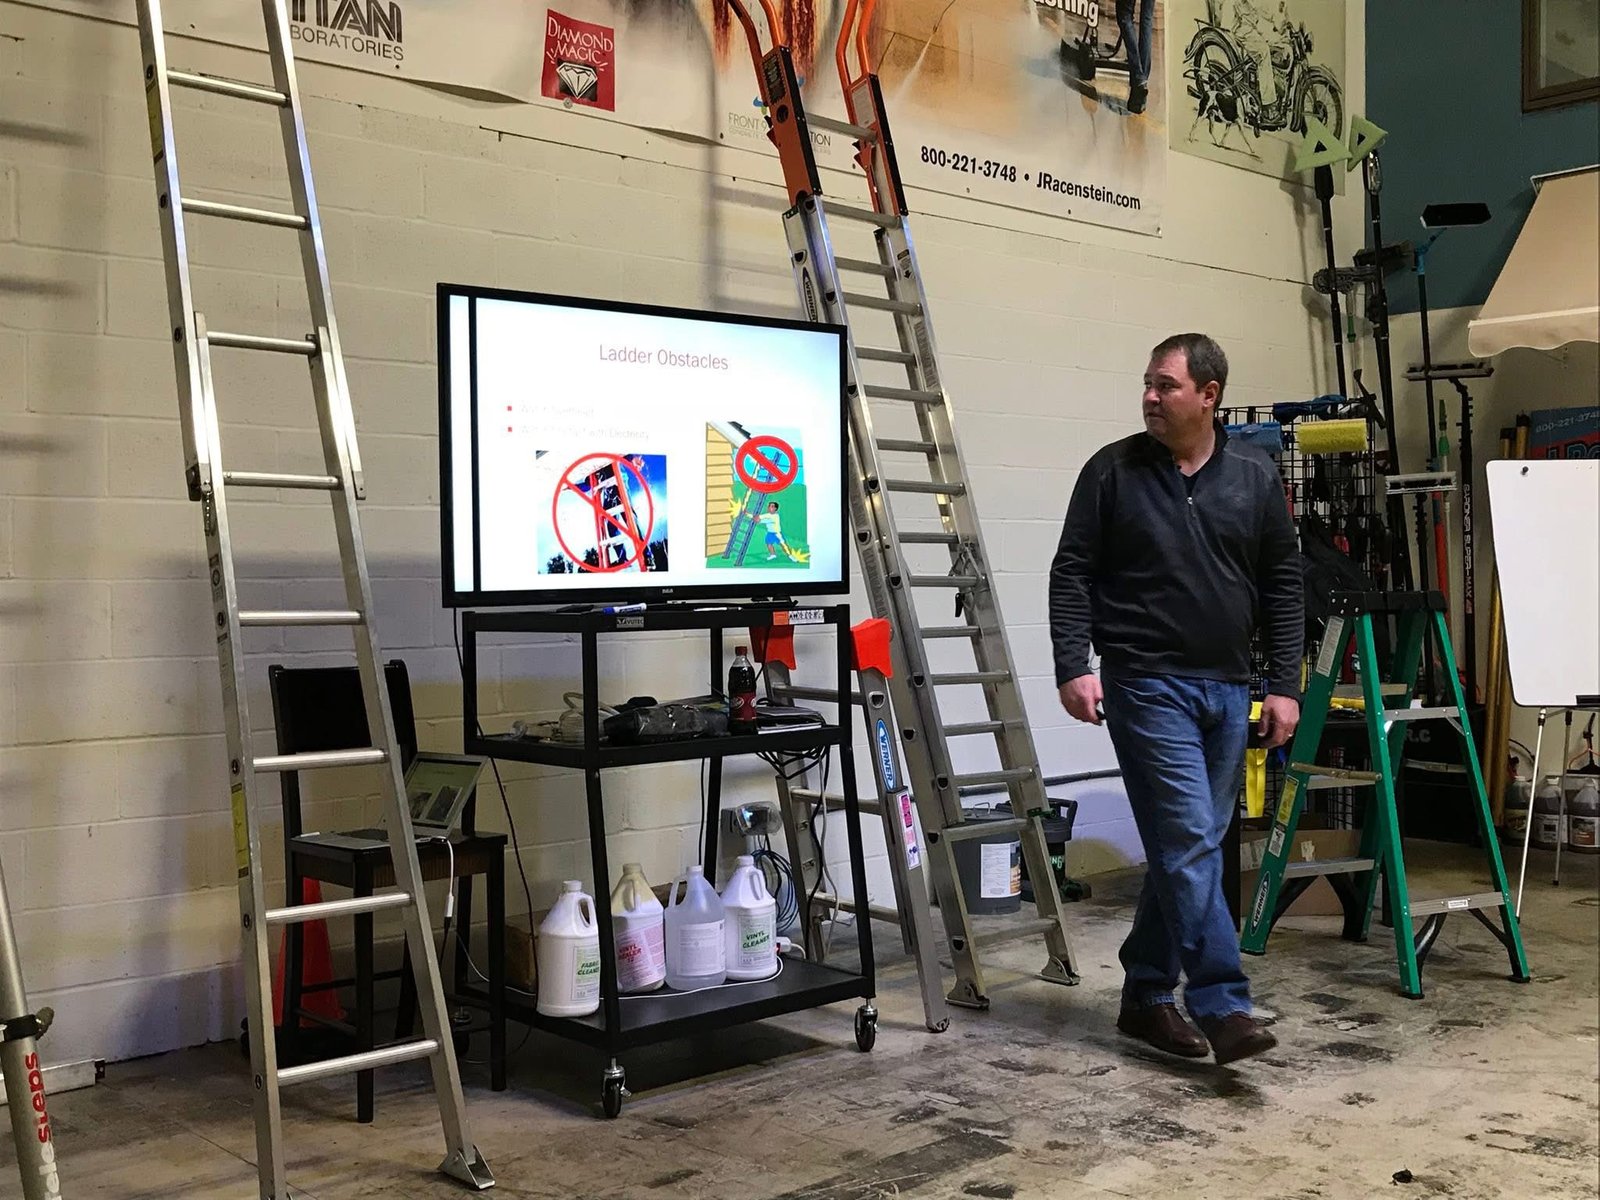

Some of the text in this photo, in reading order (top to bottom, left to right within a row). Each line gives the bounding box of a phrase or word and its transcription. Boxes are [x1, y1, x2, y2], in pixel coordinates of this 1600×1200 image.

[290, 24, 404, 61] BORATORIES
[547, 16, 614, 52] DIAMOND
[553, 40, 602, 64] MAGIC
[728, 112, 760, 133] FRONT
[920, 145, 1141, 210] 800-221-3748 JRacenstein.com
[599, 343, 729, 370] Ladder Obstacles
[880, 734, 893, 782] WERNER
[1253, 885, 1268, 923] WERNER
[742, 934, 770, 949] CLEANER
[746, 930, 765, 941] VINYL
